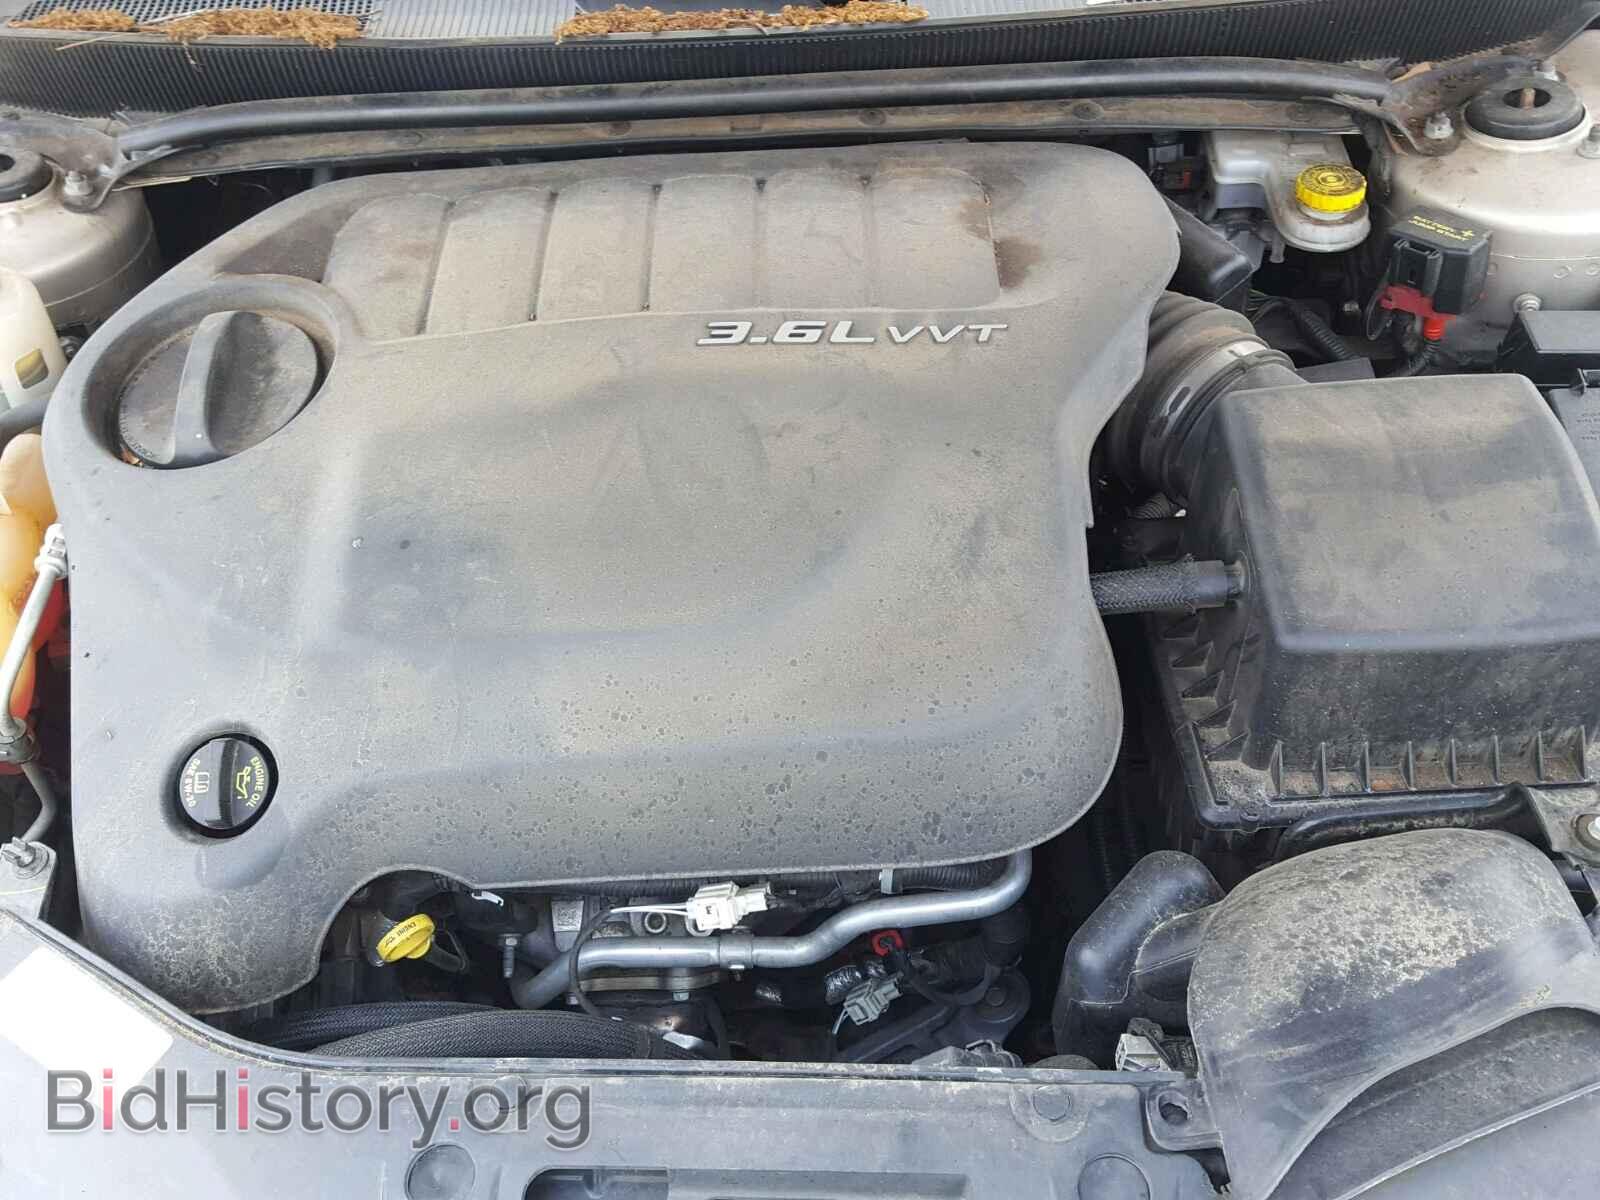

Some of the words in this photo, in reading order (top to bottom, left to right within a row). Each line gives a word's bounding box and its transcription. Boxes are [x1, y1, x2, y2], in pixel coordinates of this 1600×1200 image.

[696, 320, 875, 347] 3.6L
[887, 323, 1008, 344] VVT
[184, 758, 201, 777] SAE
[250, 755, 265, 791] ENGINE
[245, 792, 261, 808] OIL
